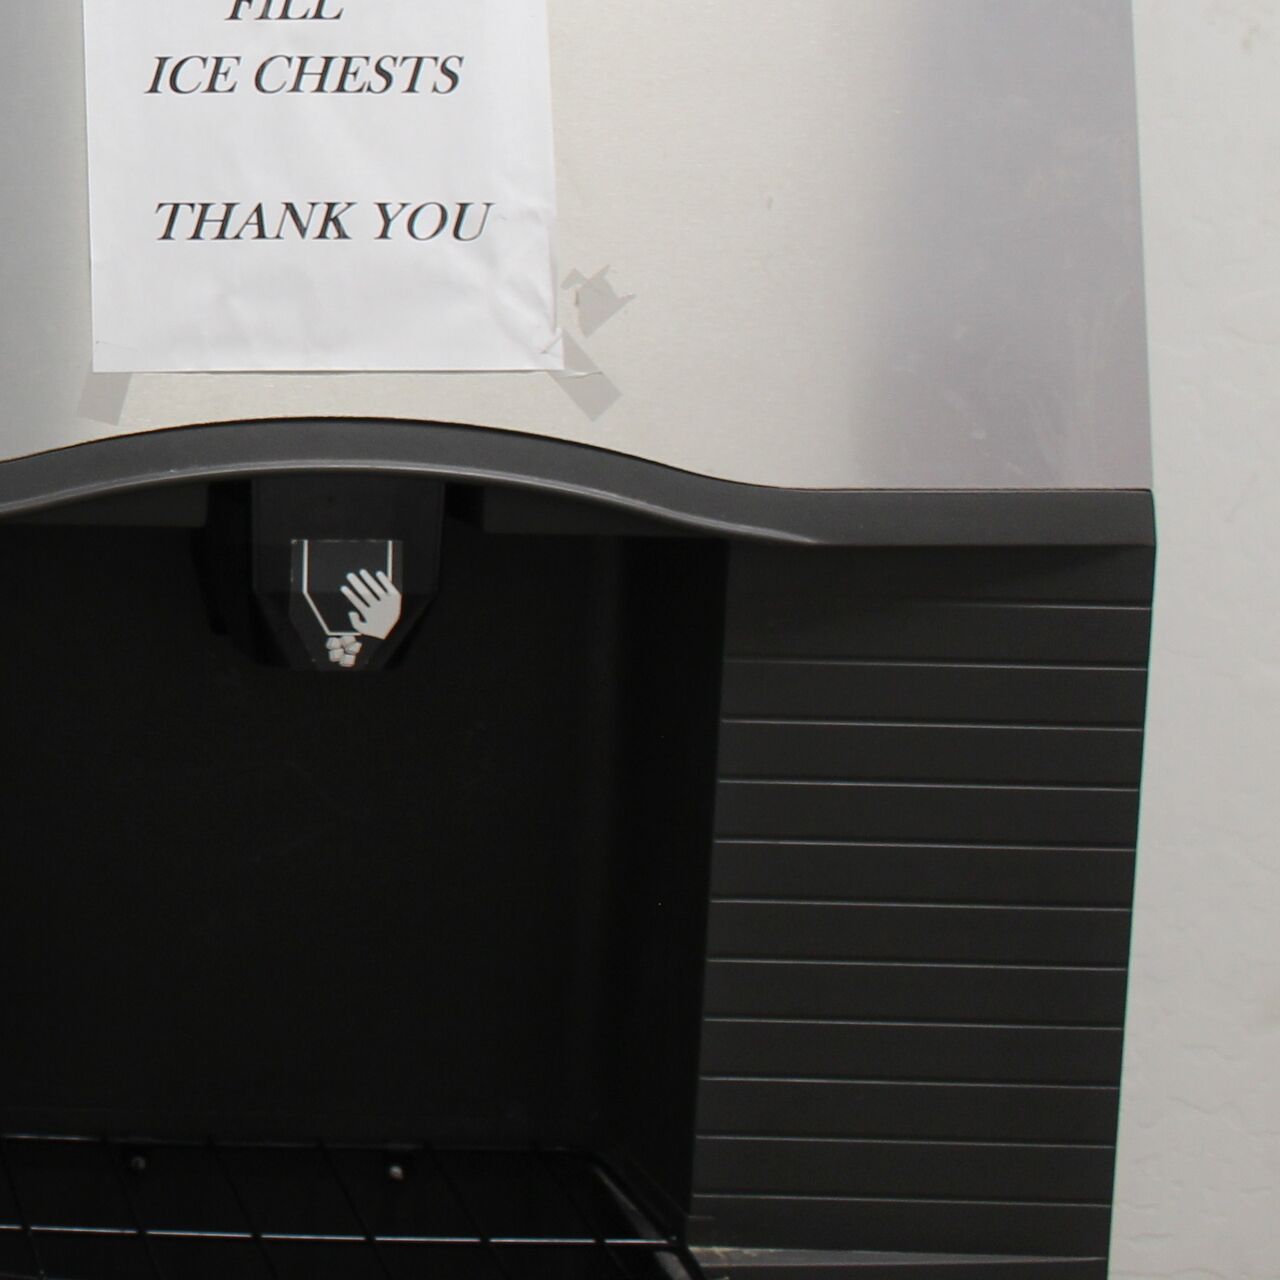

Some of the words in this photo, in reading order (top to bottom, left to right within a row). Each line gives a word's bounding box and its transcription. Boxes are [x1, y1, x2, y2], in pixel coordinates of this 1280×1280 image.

[144, 55, 242, 95] ICE
[253, 55, 465, 95] CHESTS
[155, 202, 357, 241] THANK
[373, 201, 496, 241] YOU
